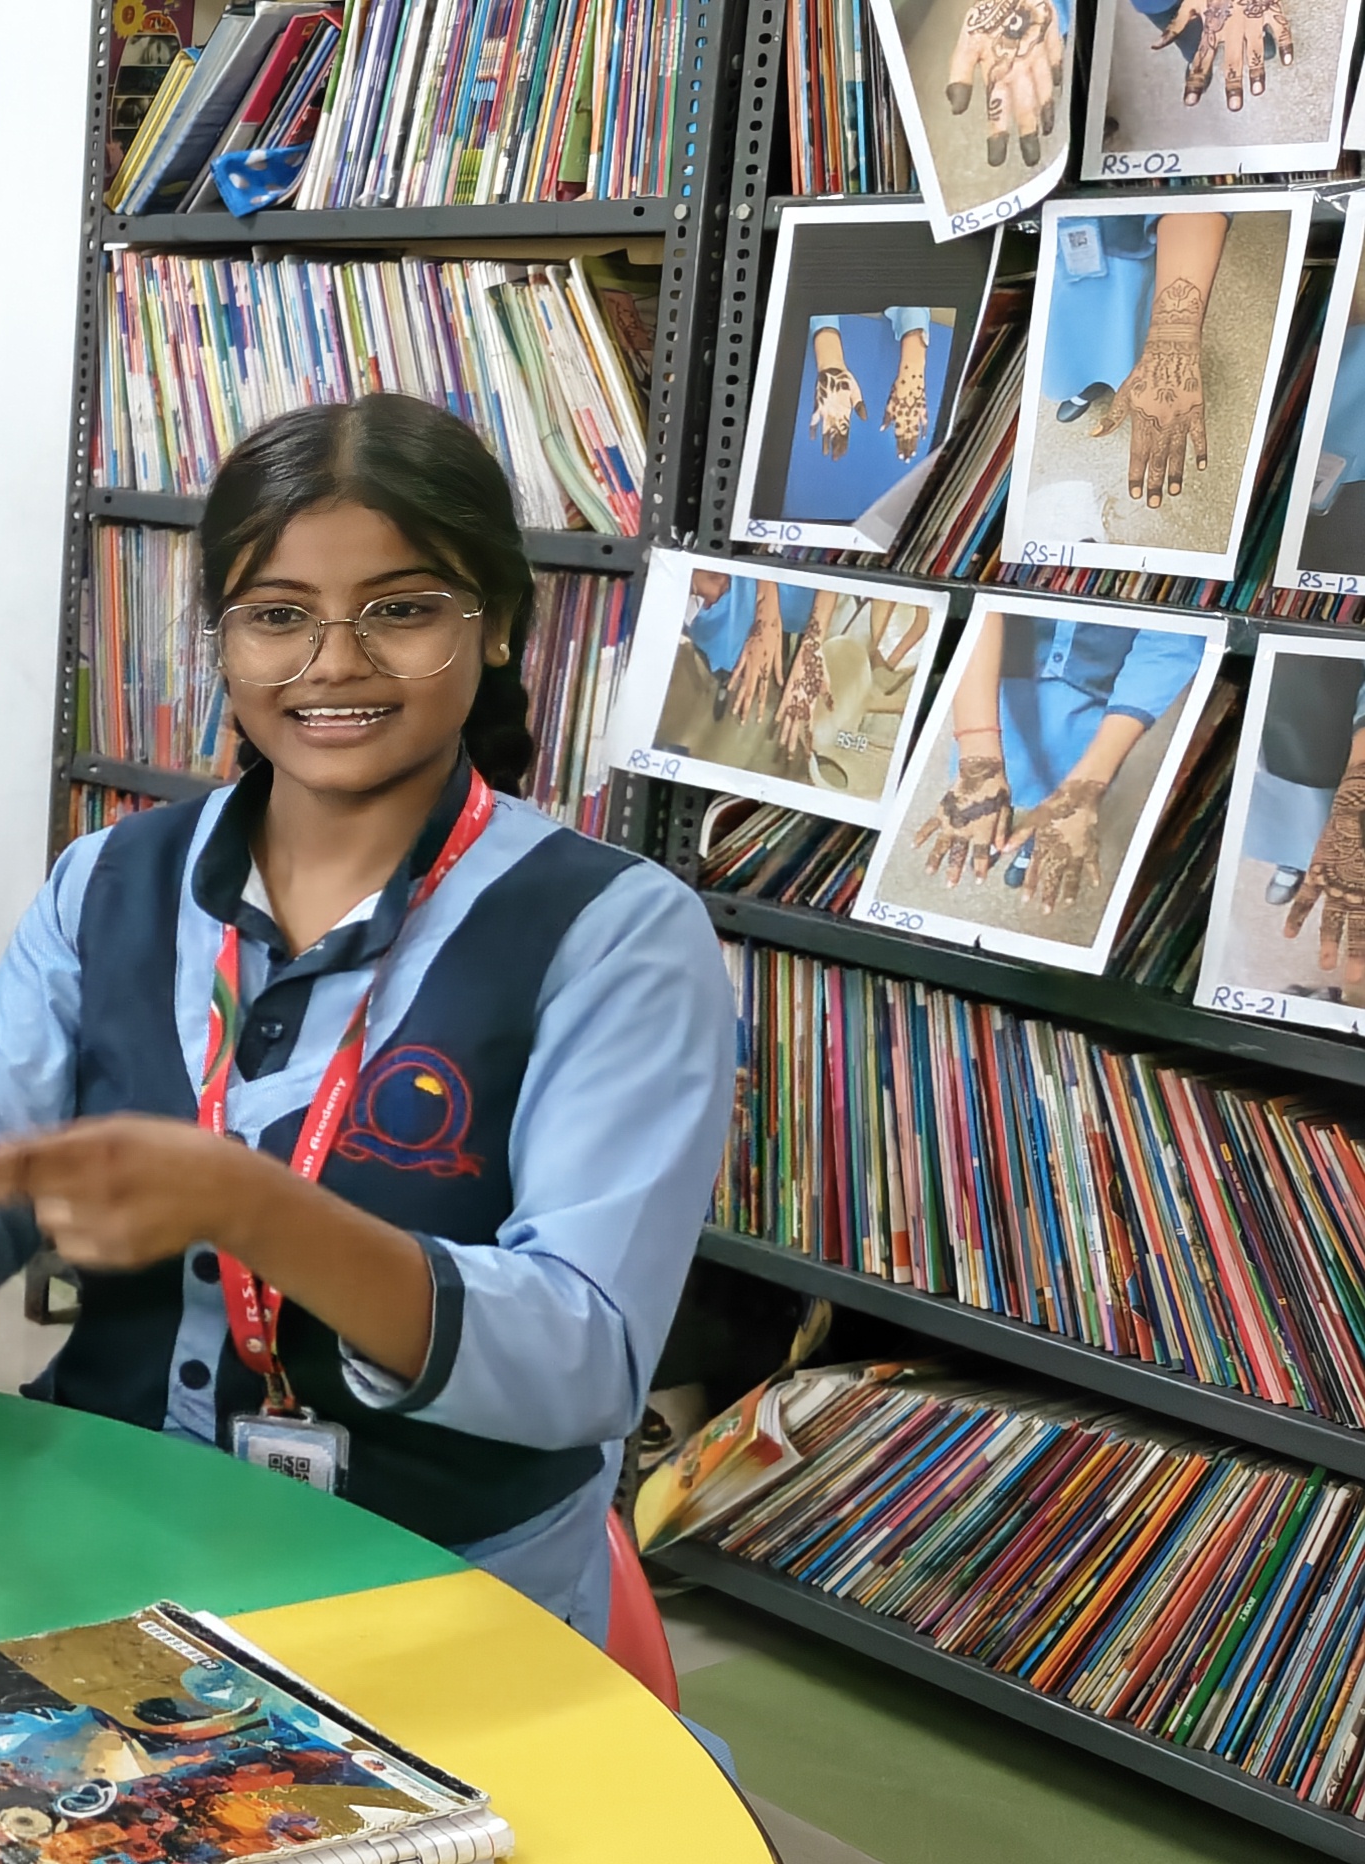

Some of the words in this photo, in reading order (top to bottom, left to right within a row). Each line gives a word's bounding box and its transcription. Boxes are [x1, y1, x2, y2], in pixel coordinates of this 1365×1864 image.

[1101, 153, 1182, 175] RS-02
[951, 195, 1023, 235] RS-01
[746, 519, 802, 541] RS-10
[1021, 541, 1074, 567] RS-11
[1297, 572, 1359, 594] RS-12
[836, 730, 869, 753] RS-19
[626, 750, 682, 780] RS-19
[867, 901, 924, 931] RS-20
[1211, 986, 1287, 1019] RS-21
[312, 1078, 346, 1150] Academy
